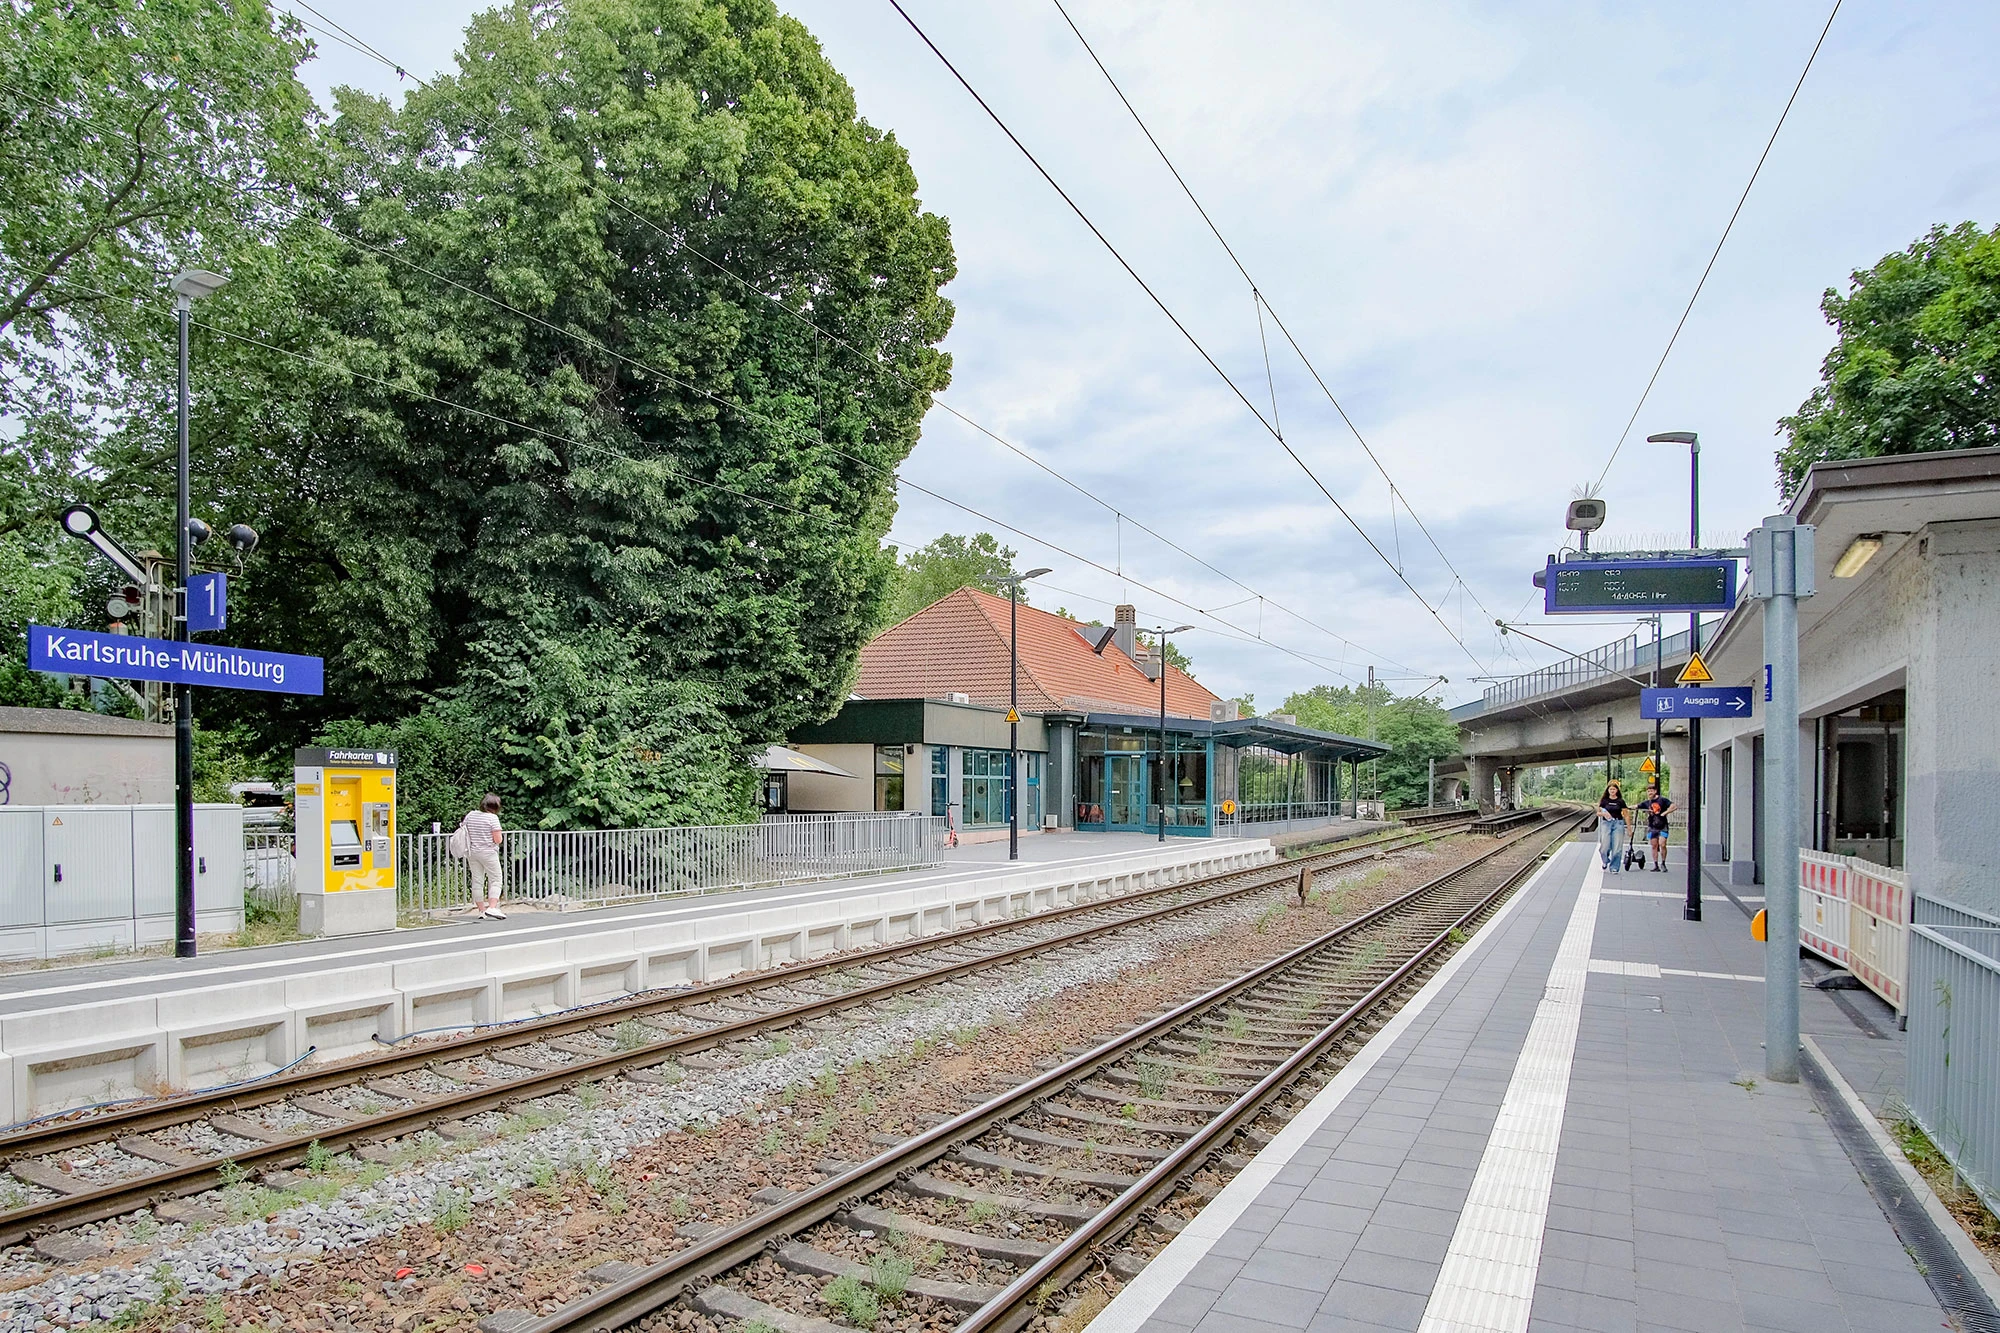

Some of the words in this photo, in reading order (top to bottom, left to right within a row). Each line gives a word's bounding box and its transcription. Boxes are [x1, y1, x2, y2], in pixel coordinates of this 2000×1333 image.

[205, 579, 215, 616] 1
[47, 635, 285, 683] Karlsruhe-Mühlburg
[1683, 696, 1720, 706] Ausgang
[329, 750, 374, 761] Fahrkarten
